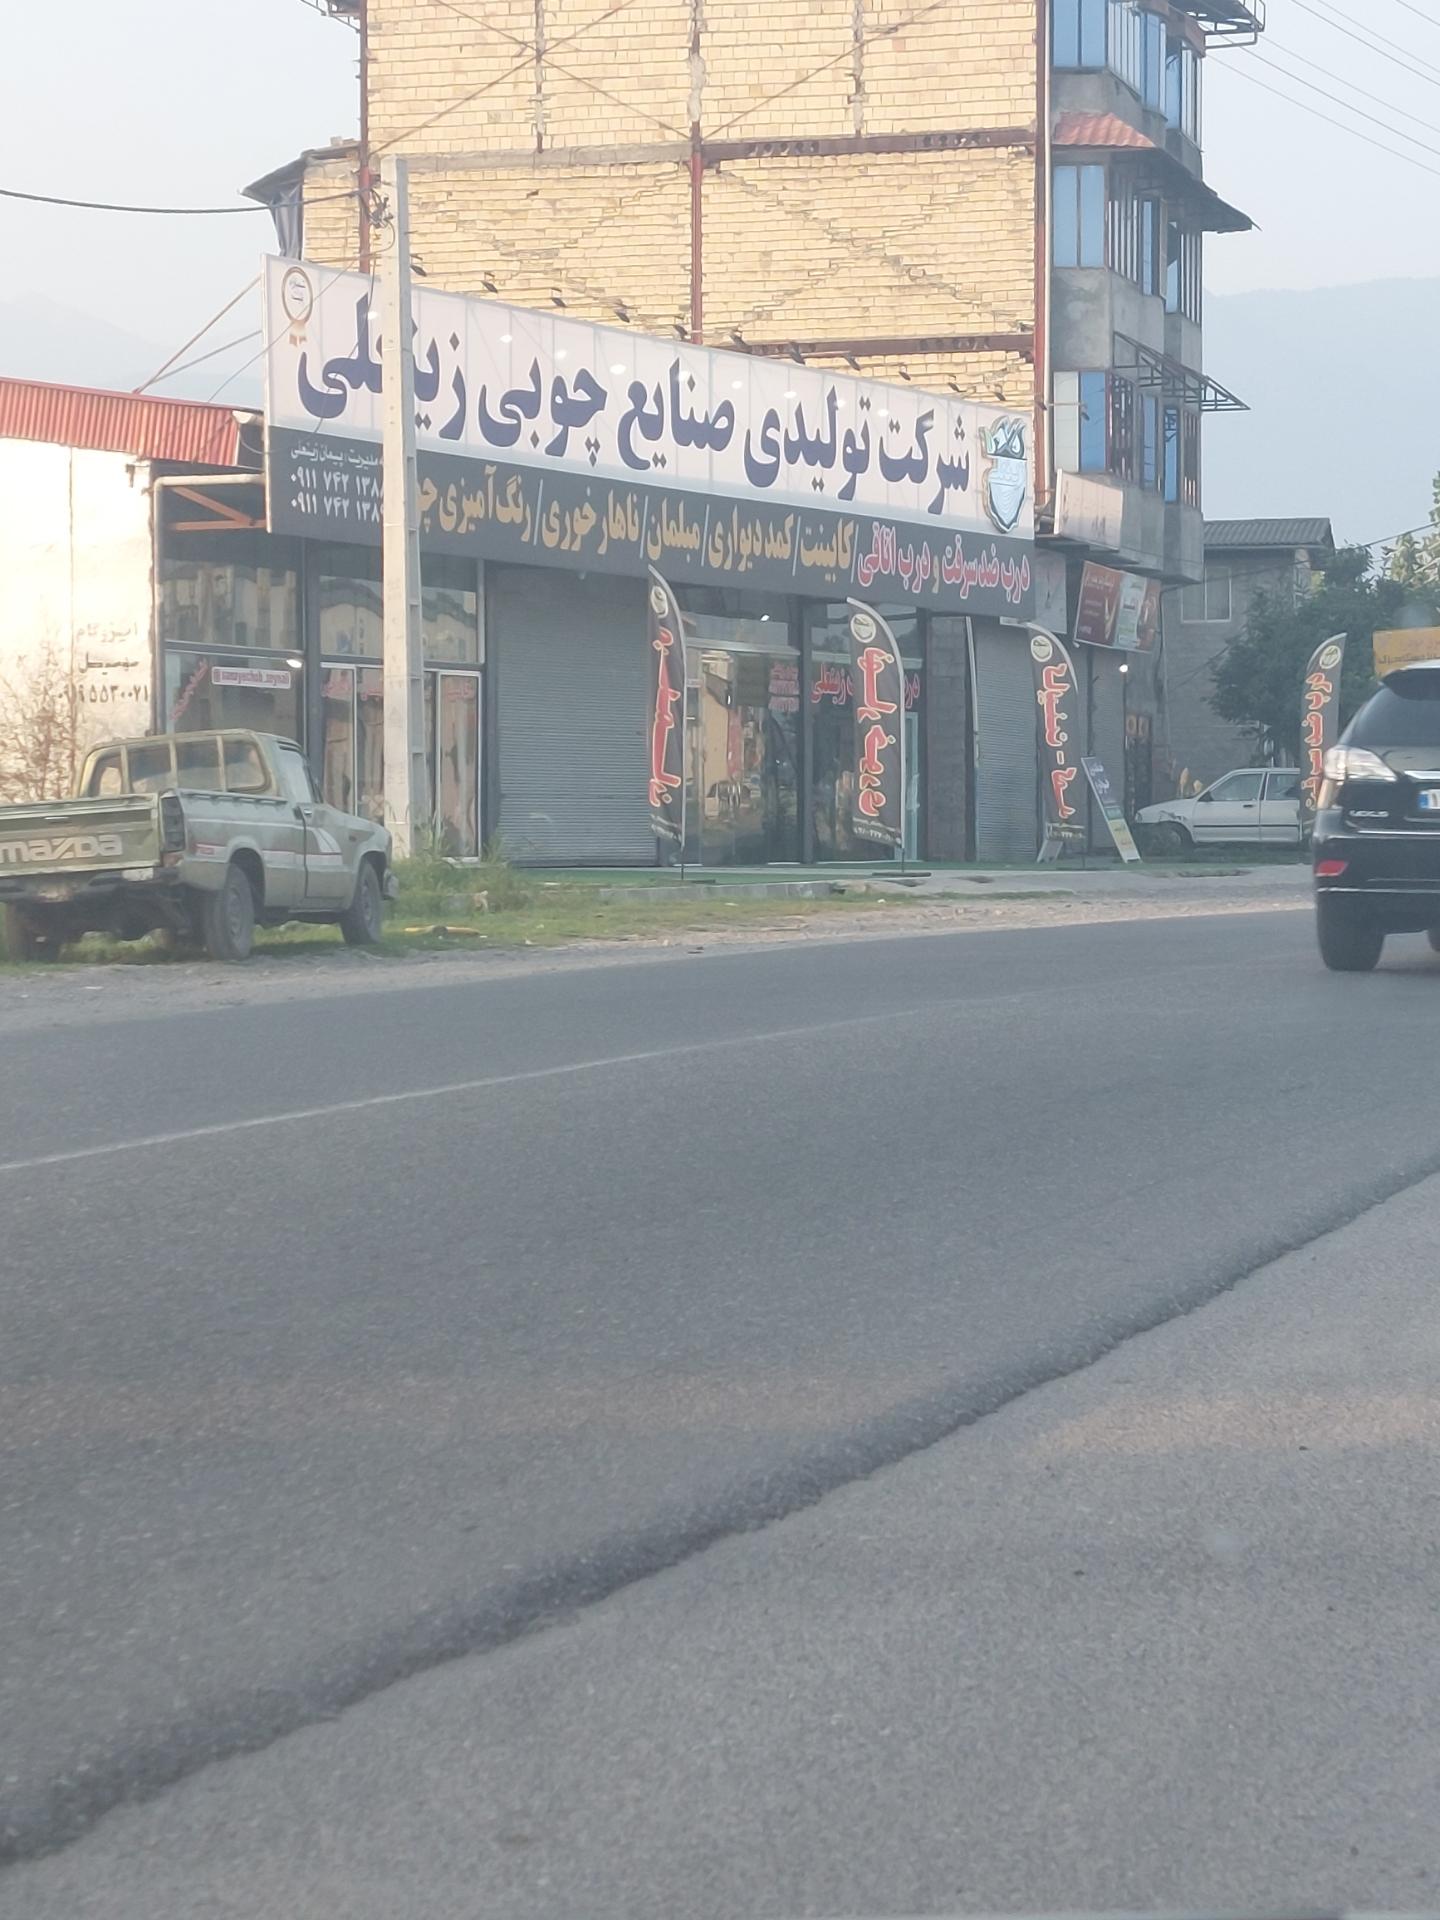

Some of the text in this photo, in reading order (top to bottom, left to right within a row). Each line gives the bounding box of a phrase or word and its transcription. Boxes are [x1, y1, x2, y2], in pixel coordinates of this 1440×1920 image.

[478, 356, 608, 467] چوبی
[617, 357, 736, 471] صنایع
[743, 385, 872, 502] تولیدی
[290, 466, 317, 489] ۰۹۱۱
[323, 470, 349, 494] ۷۴۲
[878, 407, 970, 515] شرکت
[290, 491, 317, 515] ۰۹۱۱
[323, 496, 350, 519] ۷۴۲
[439, 464, 497, 535] آمیزی
[495, 474, 531, 543] رنگ
[541, 486, 597, 554] خوری
[597, 488, 640, 555] ناهار
[646, 496, 701, 562] مبلمان
[708, 505, 762, 572] دیواری
[765, 512, 794, 562] کمد
[800, 517, 855, 583] کابینت
[857, 520, 897, 588] اتاقی
[898, 541, 931, 593] درب
[941, 533, 978, 600] سرقت
[1000, 554, 1030, 604] درب
